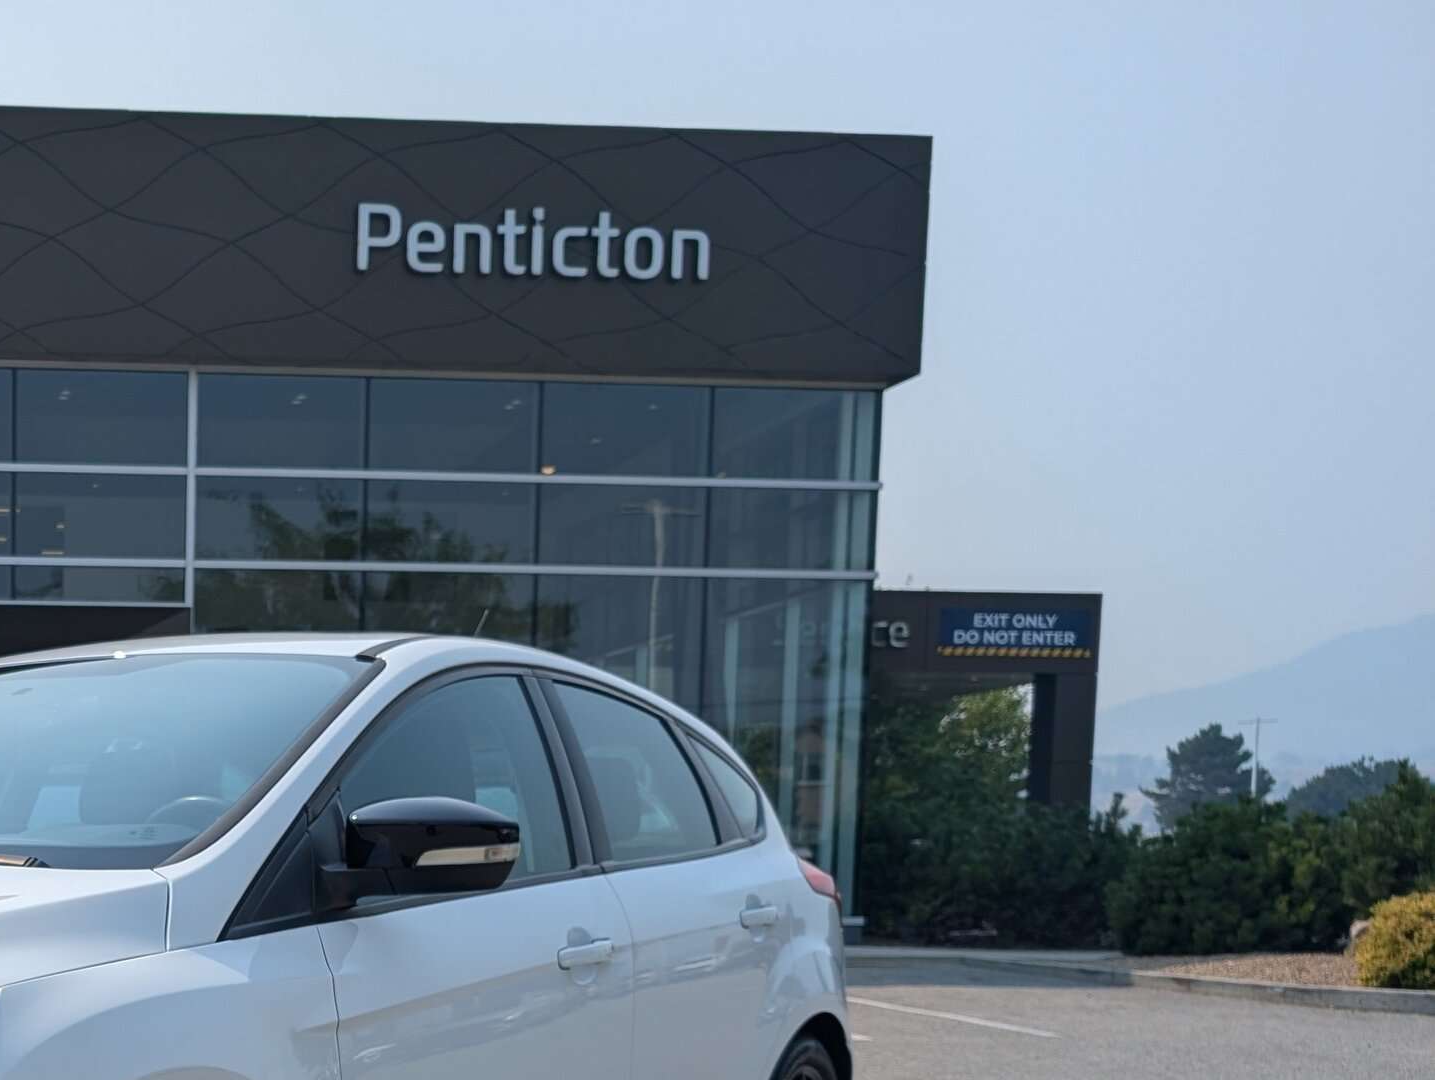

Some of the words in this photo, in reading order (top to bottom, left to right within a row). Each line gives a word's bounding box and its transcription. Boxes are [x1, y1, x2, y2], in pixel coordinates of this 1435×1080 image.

[356, 202, 710, 281] Penticton
[973, 613, 1010, 629] EXIT
[1012, 613, 1059, 629] ONLY
[953, 629, 980, 645] DO
[983, 630, 1019, 645] NOT
[1022, 631, 1077, 646] ENTER
